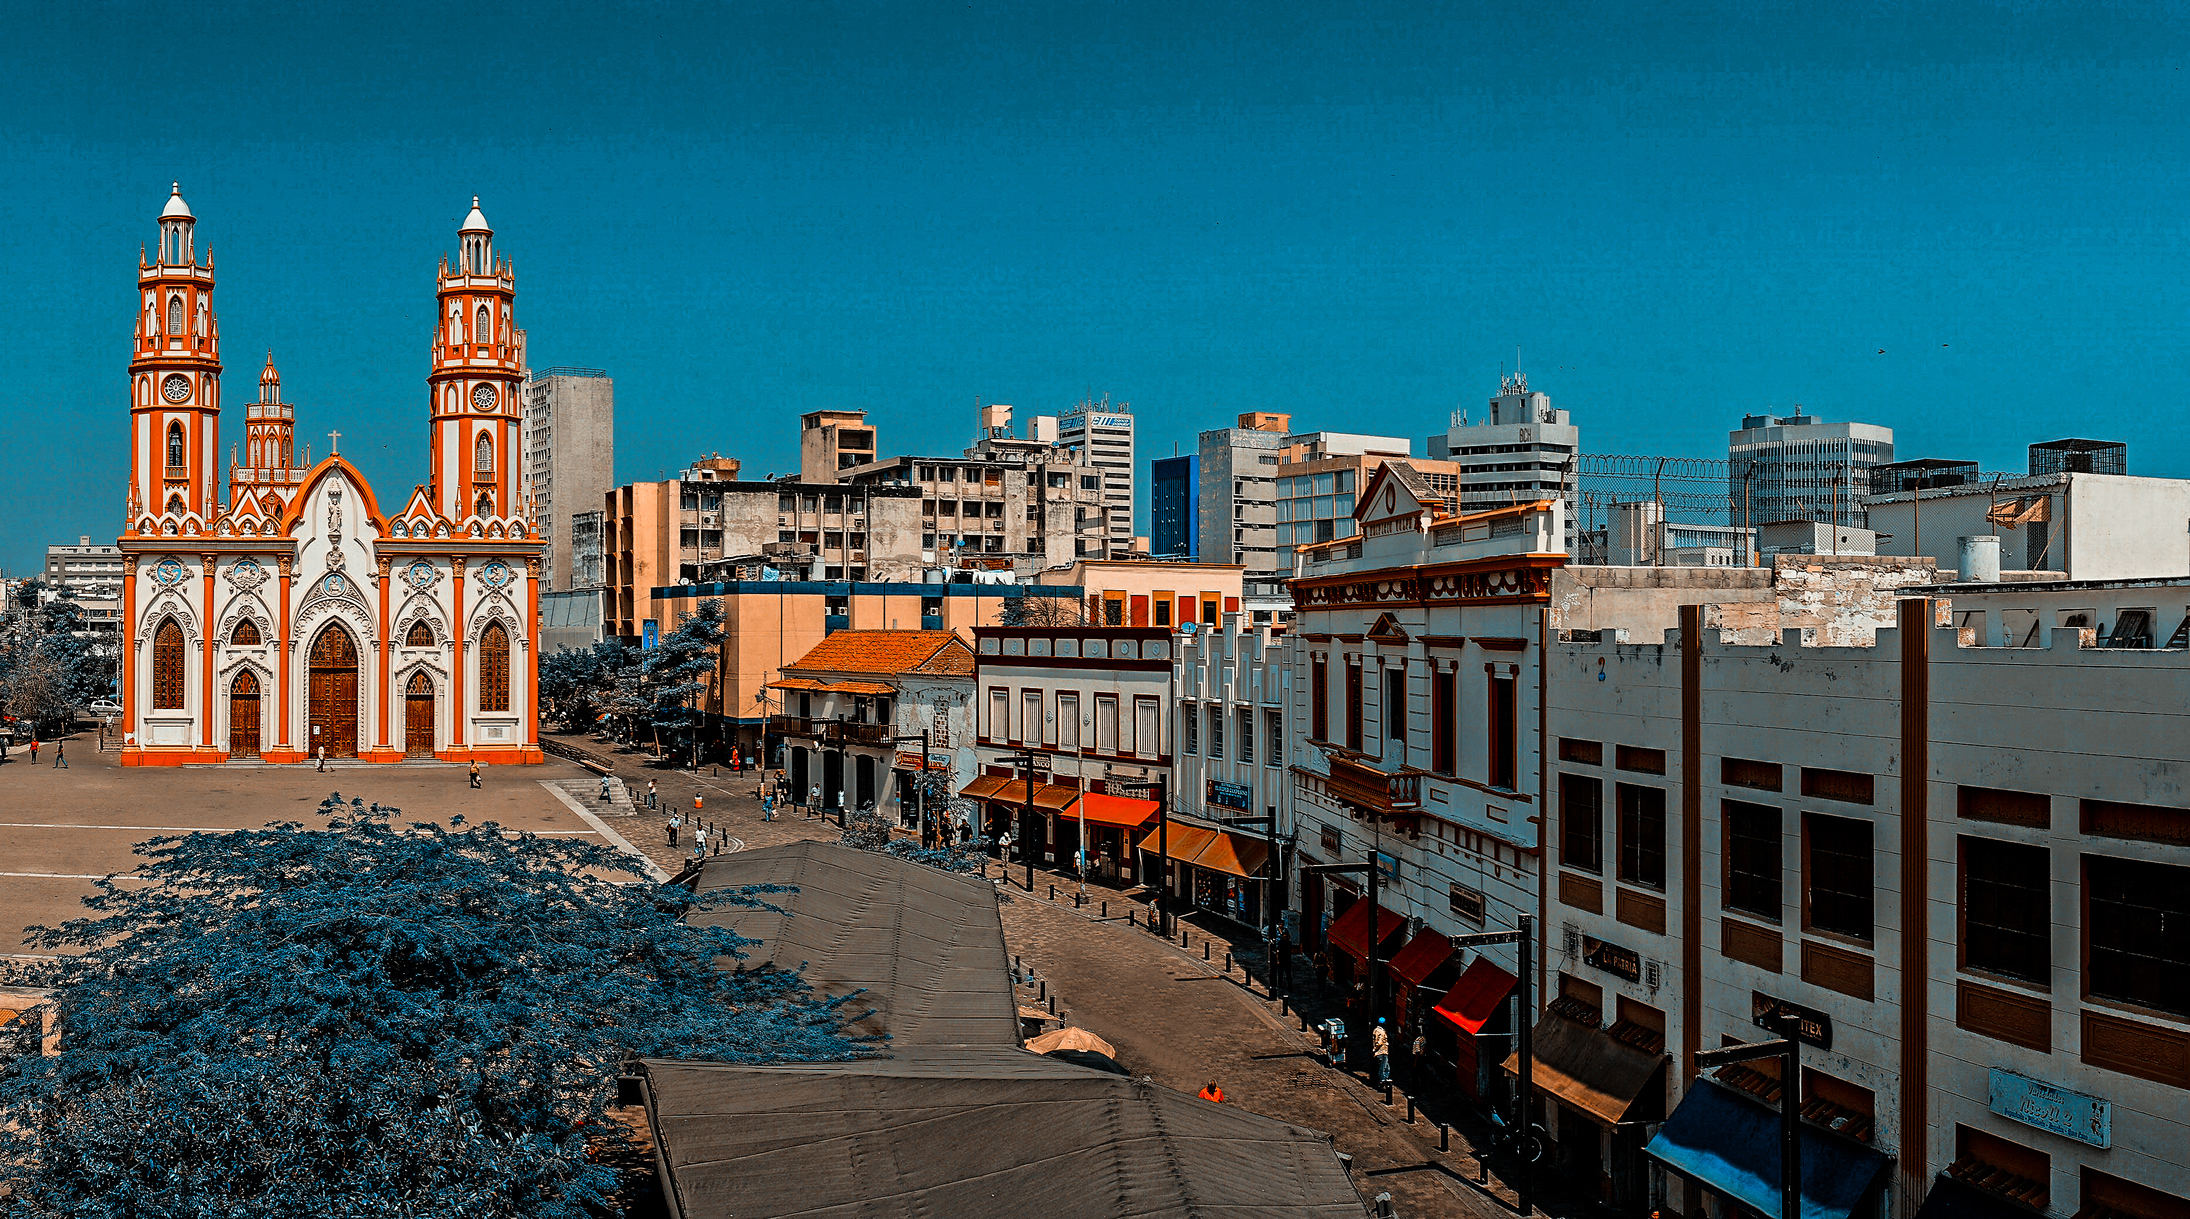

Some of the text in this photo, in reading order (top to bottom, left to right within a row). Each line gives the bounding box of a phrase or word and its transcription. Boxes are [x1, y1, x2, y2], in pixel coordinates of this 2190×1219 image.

[1603, 952, 1612, 965] LA
[1613, 955, 1638, 975] PATRIA
[1800, 1018, 1822, 1037] ITEX
[2028, 1086, 2065, 1105] Variedades
[2063, 1111, 2073, 1127] 2
